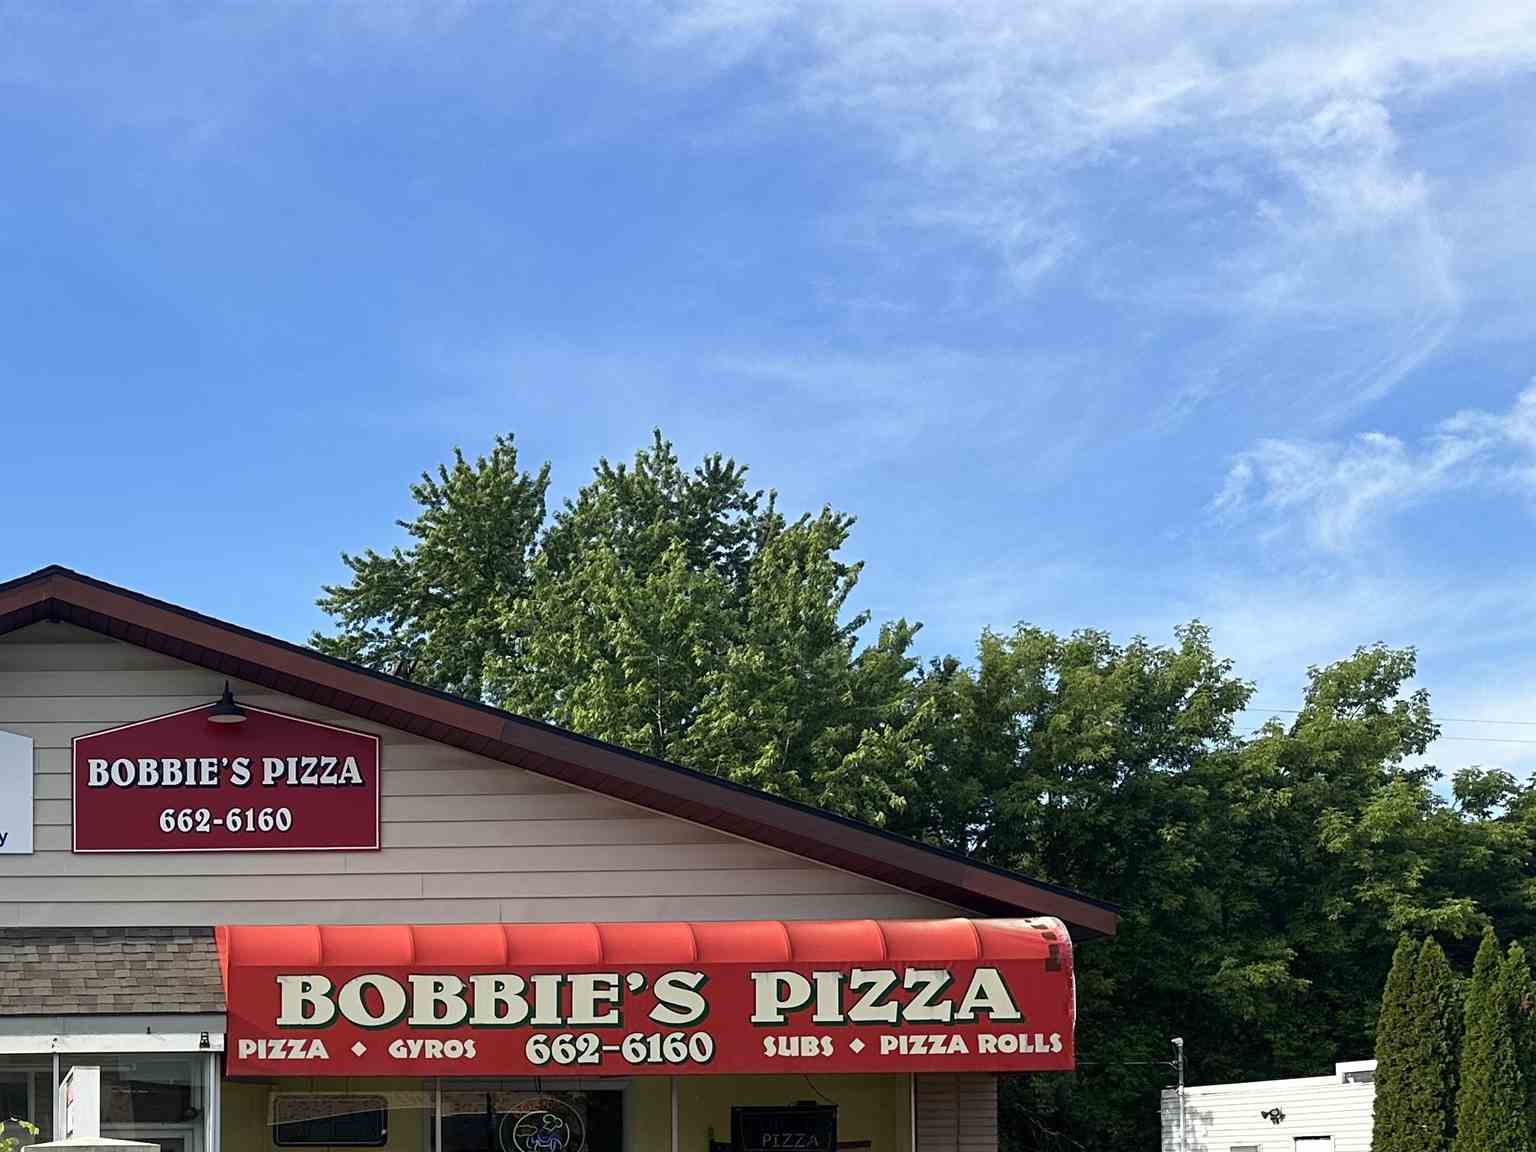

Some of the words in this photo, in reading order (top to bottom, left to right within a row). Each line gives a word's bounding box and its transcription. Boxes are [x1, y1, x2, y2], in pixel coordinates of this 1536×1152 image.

[87, 756, 252, 787] BOBBIE'S
[262, 756, 364, 786] PIZZA
[159, 807, 293, 833] 662-6160
[275, 970, 709, 1027] BOBBIE'S
[750, 967, 1024, 1025] PIZZA
[238, 1038, 329, 1061] PIZZA
[387, 1038, 477, 1060] GYROS
[524, 1031, 715, 1067] 662-6160
[762, 1034, 835, 1057] SUBS
[880, 1034, 970, 1055] PIZZA
[977, 1032, 1064, 1054] ROLLS
[762, 1132, 819, 1149] PIZZA
